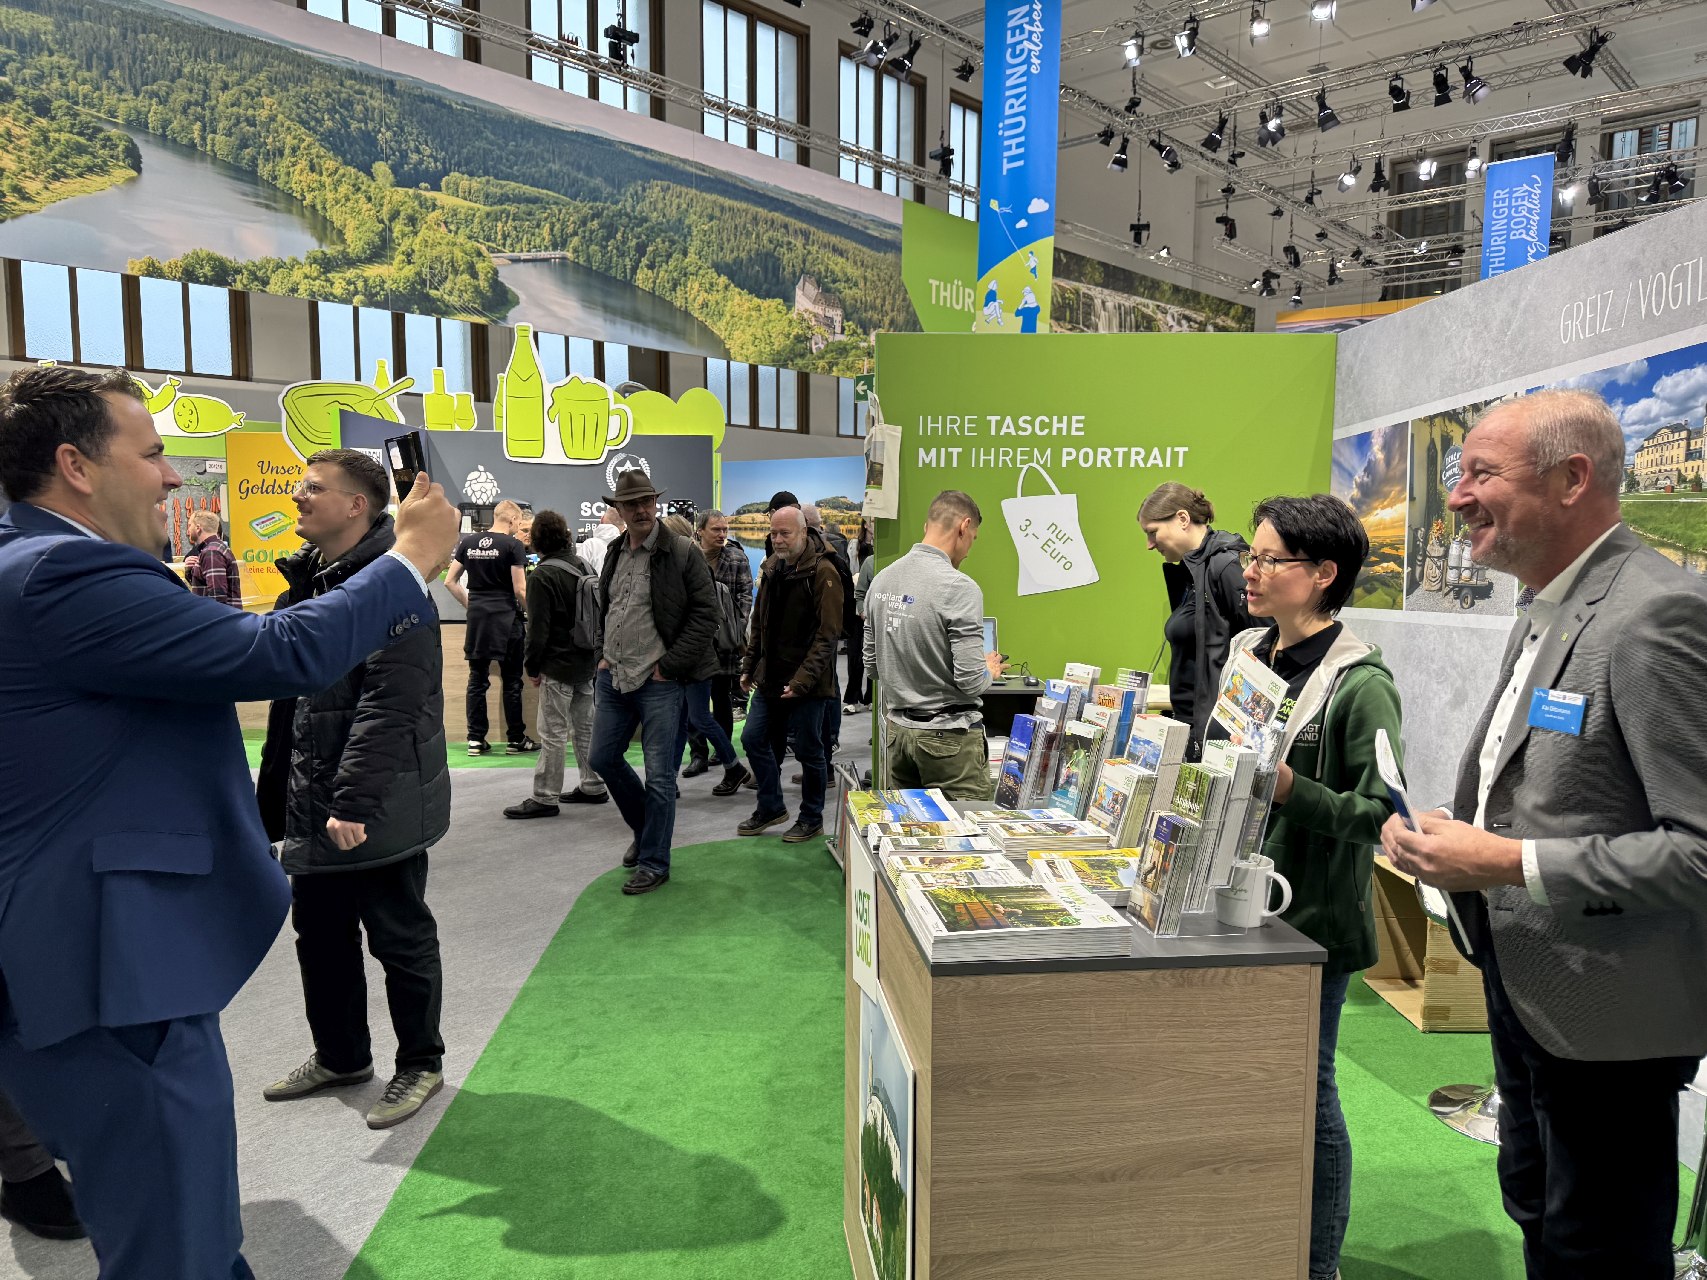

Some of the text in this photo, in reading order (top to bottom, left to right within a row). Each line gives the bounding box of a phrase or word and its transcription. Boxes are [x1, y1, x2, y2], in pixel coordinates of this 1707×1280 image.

[998, 4, 1030, 176] THÜRINGEN
[1510, 183, 1529, 240] BOGEN
[1486, 187, 1510, 278] THÜRINGER
[1560, 288, 1614, 344] GREIZ
[1638, 256, 1707, 320] VOGTL
[918, 415, 1085, 436] IHRE TASCHE
[256, 460, 303, 475] Unser
[918, 446, 1189, 468] MIT IHREM PORTRAIT
[1046, 521, 1074, 545] nur
[1040, 537, 1074, 572] Euro
[854, 888, 871, 929] VOGT
[855, 923, 872, 968] LAND
